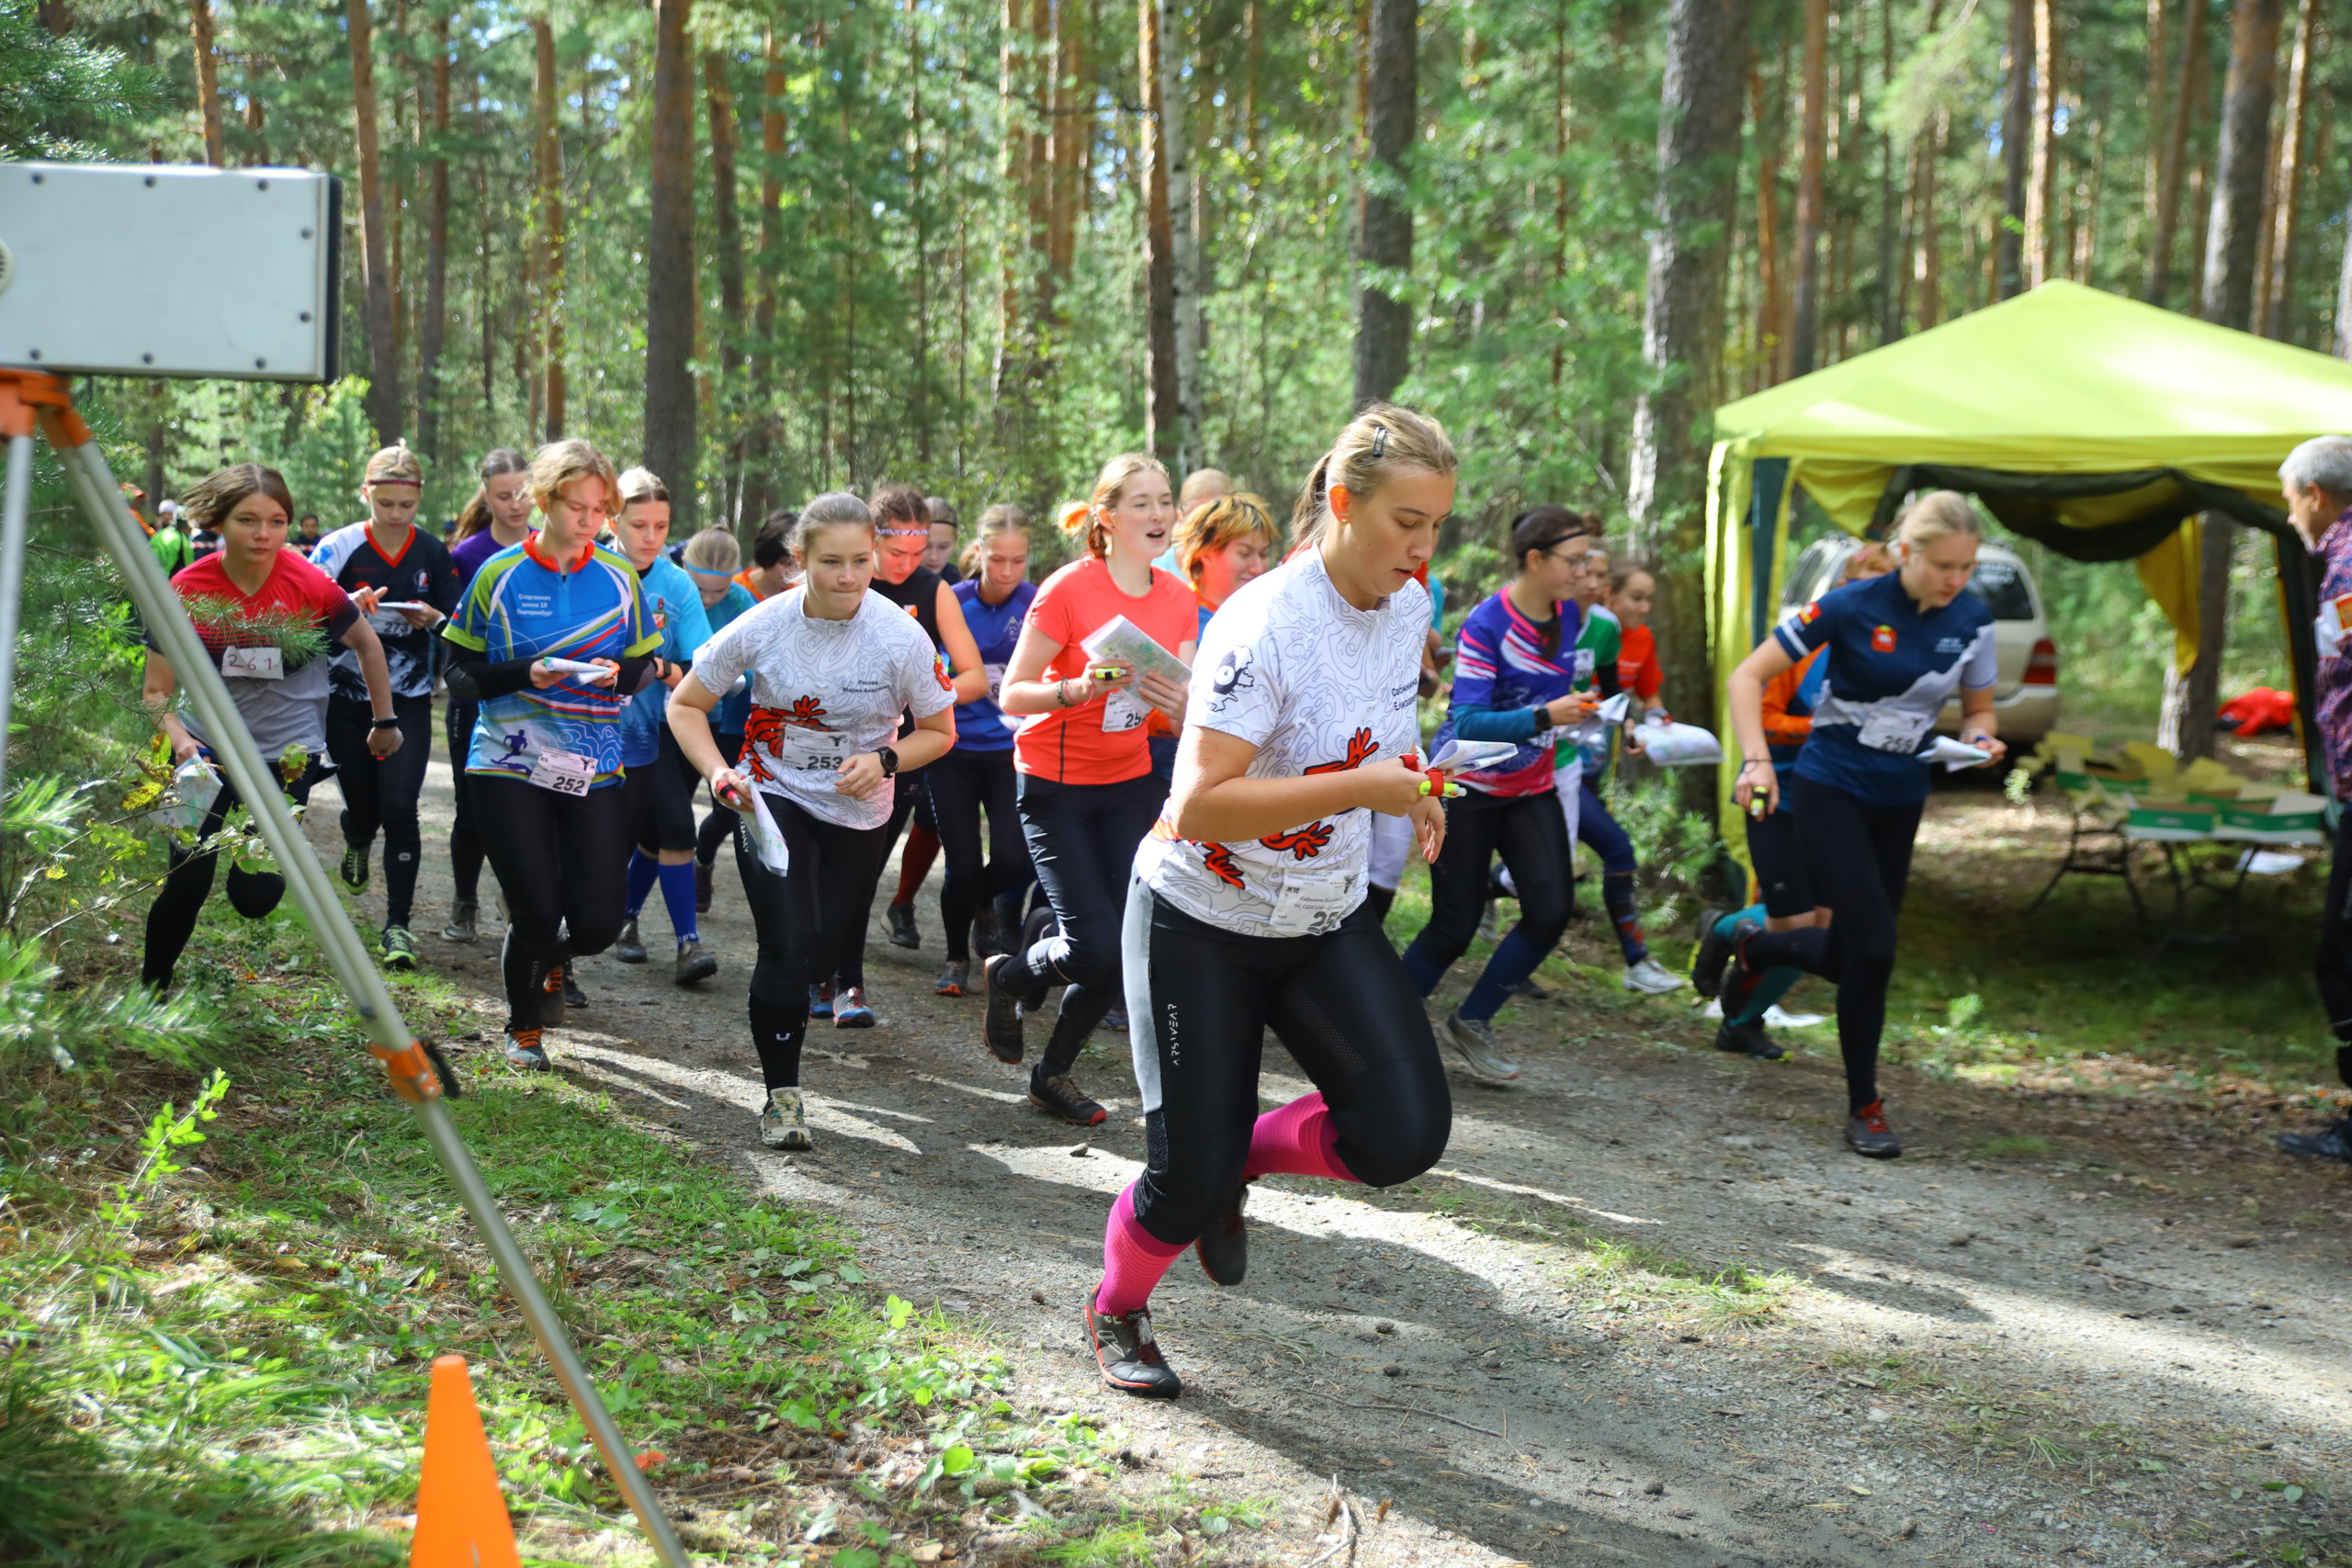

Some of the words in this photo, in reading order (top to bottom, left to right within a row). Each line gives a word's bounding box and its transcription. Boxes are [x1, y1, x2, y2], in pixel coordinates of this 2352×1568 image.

[228, 654, 272, 671] 261
[808, 755, 844, 770] 253
[552, 775, 585, 794] 252
